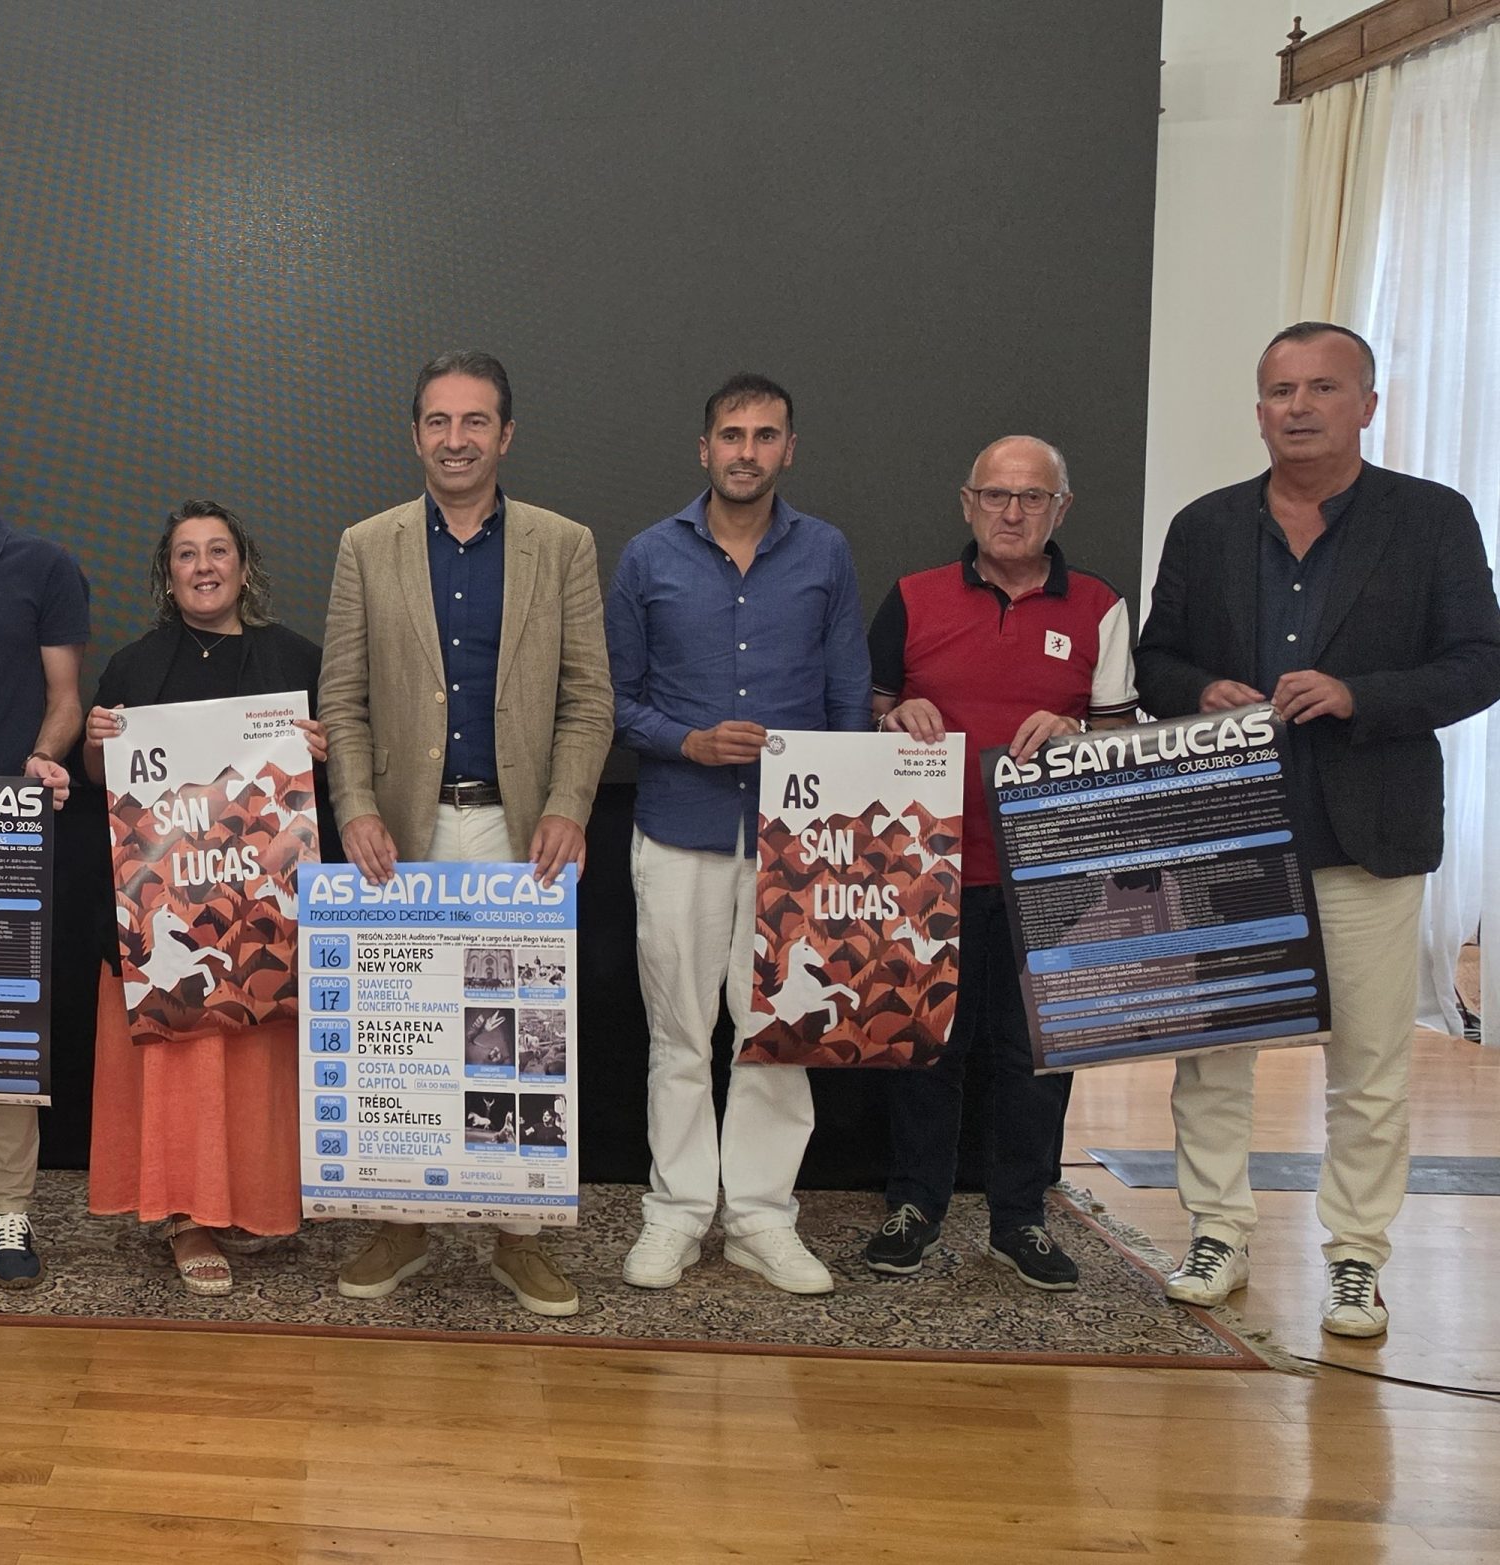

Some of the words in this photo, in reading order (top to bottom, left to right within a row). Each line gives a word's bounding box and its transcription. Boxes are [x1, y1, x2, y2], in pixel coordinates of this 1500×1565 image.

[245, 708, 295, 719] Mondoñedo
[252, 721, 262, 729] 16
[275, 719, 294, 727] 25-X
[243, 731, 272, 740] Outono
[898, 747, 947, 756] Mondoñedo
[994, 751, 1042, 788] AS
[1045, 736, 1126, 779] SAN
[1131, 710, 1275, 765] LUCAS
[130, 747, 168, 784] AS
[925, 759, 947, 767] 25-X
[894, 769, 922, 777] Outono
[924, 769, 947, 777] 2026
[998, 777, 1092, 802] MONDOÑEDO
[1095, 769, 1147, 787] DENDE
[1150, 764, 1176, 778] 1156
[1247, 748, 1279, 764] 2026
[783, 773, 820, 809] AS
[154, 796, 210, 836] SAN
[16, 821, 43, 833] 2026
[800, 828, 854, 866] SAN
[172, 845, 261, 887] LUCAS
[308, 872, 354, 905] AS
[359, 872, 432, 905] SAN
[438, 873, 566, 906] LUCAS
[814, 883, 900, 921] LUCAS
[310, 909, 396, 922] MONDOÑEDO
[399, 909, 446, 921] DENDE
[450, 910, 471, 922] 1156
[537, 912, 565, 923] 2026
[357, 932, 385, 941] PREGÓN.
[385, 933, 401, 941] 20:30
[409, 933, 436, 941] Auditorio
[523, 936, 538, 944] Rego
[319, 948, 342, 968] 16
[357, 948, 380, 959] LOS
[383, 948, 434, 960] PLAYERS
[357, 961, 385, 973] NEW
[389, 961, 422, 973] YORK
[320, 990, 340, 1010] 17
[357, 978, 413, 990] SUAVECITO
[357, 990, 410, 1001] MARBELLA
[357, 1001, 402, 1012] CONCERTO
[404, 1002, 419, 1012] THE
[421, 1002, 459, 1013] RAPANTS
[320, 1032, 341, 1052] 18
[357, 1020, 444, 1032] SALSARENA
[358, 1032, 434, 1044] PRINCIPAL
[323, 1071, 339, 1086] 19
[358, 1062, 396, 1074] COSTA
[399, 1063, 451, 1076] DORADA
[358, 1077, 407, 1089] CAPITOL
[320, 1105, 341, 1120] 20
[358, 1094, 403, 1109] TRÉBOL
[358, 1111, 380, 1124] LOS
[383, 1110, 442, 1126] SATÉLITES
[321, 1139, 341, 1154] 23
[358, 1130, 380, 1142] LOS
[382, 1130, 451, 1145] COLEGUITAS
[358, 1142, 373, 1153] DE
[376, 1143, 443, 1156] VENEZUELA
[358, 1167, 378, 1176] ZEST
